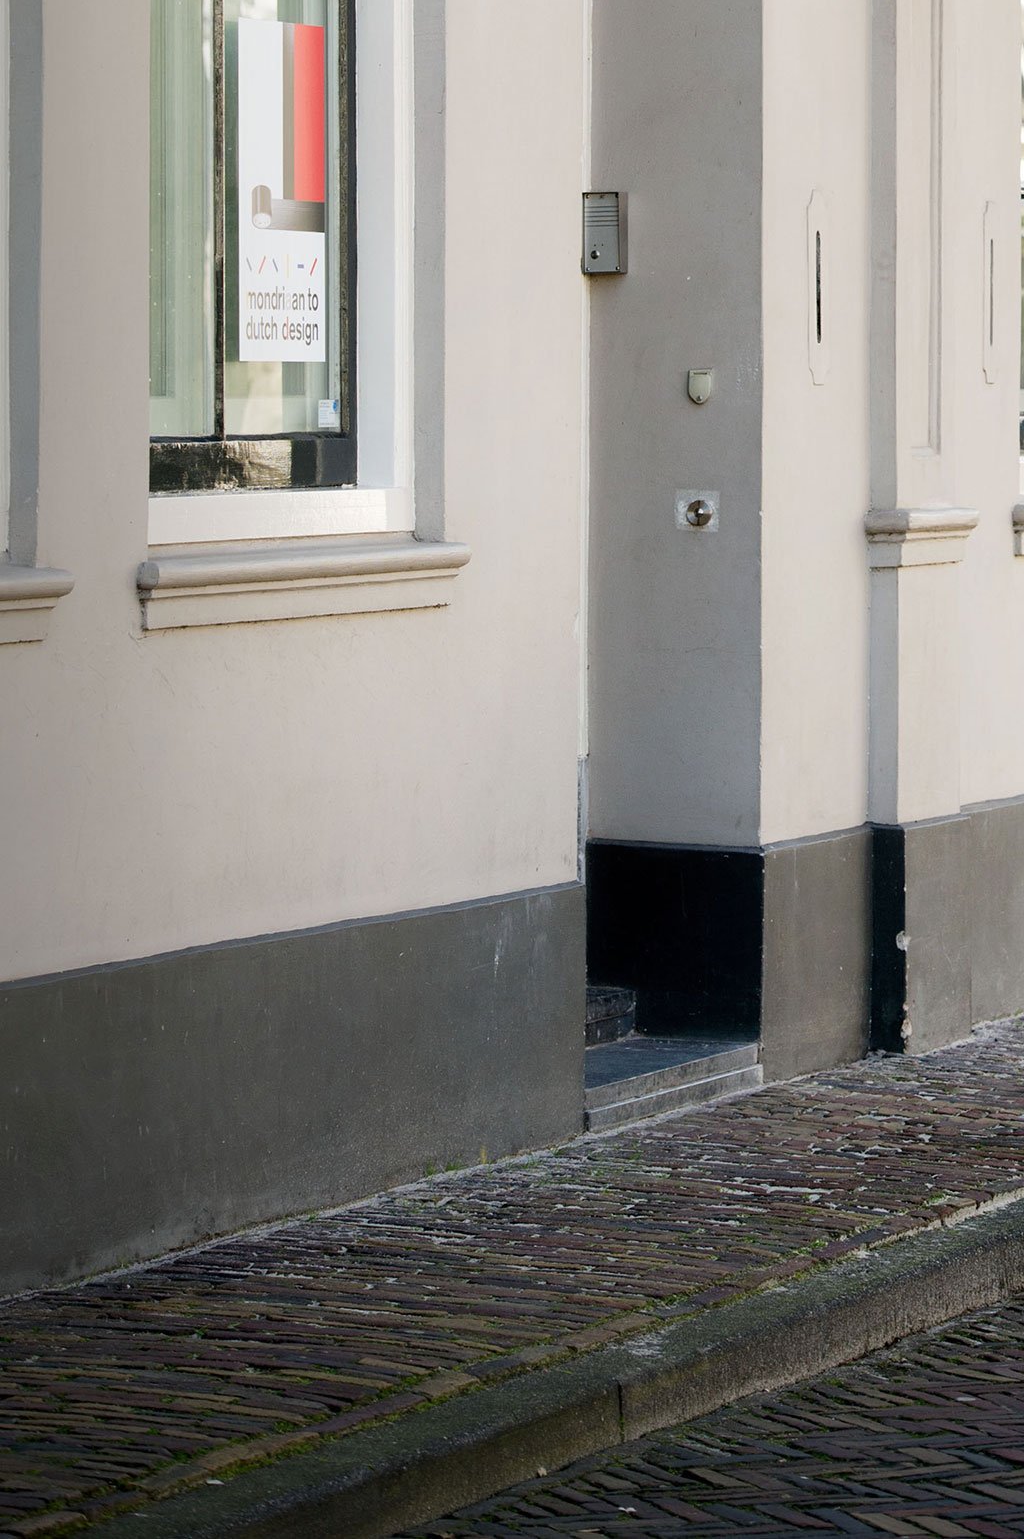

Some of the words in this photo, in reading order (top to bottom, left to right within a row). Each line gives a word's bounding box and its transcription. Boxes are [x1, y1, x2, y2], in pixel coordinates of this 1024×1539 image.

[247, 285, 305, 311] mondriaan
[308, 288, 319, 311] to
[246, 316, 278, 341] dutch
[282, 316, 319, 346] design
